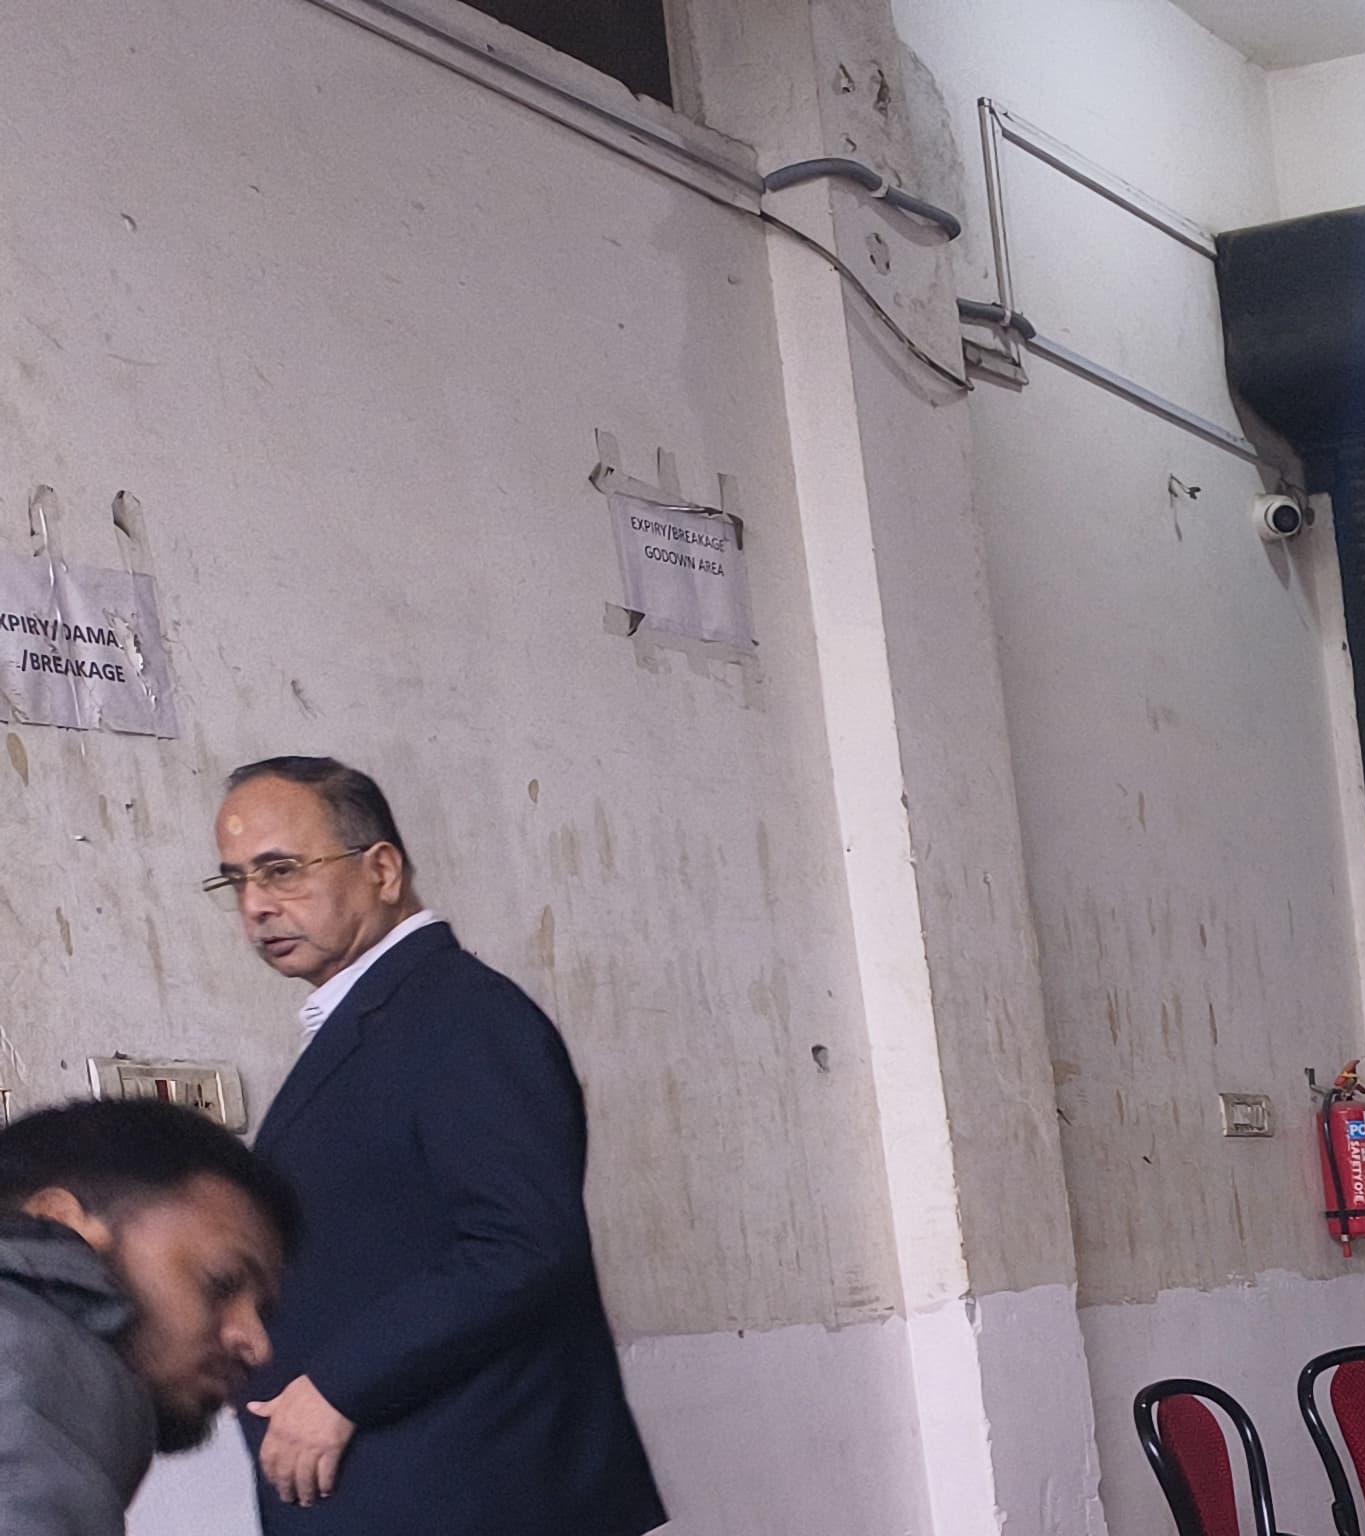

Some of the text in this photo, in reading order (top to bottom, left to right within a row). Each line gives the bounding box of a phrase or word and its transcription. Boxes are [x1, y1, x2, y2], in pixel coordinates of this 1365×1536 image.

[630, 515, 727, 553] EXPIRY/BREAKAGE
[644, 545, 726, 577] GODOWN AREA
